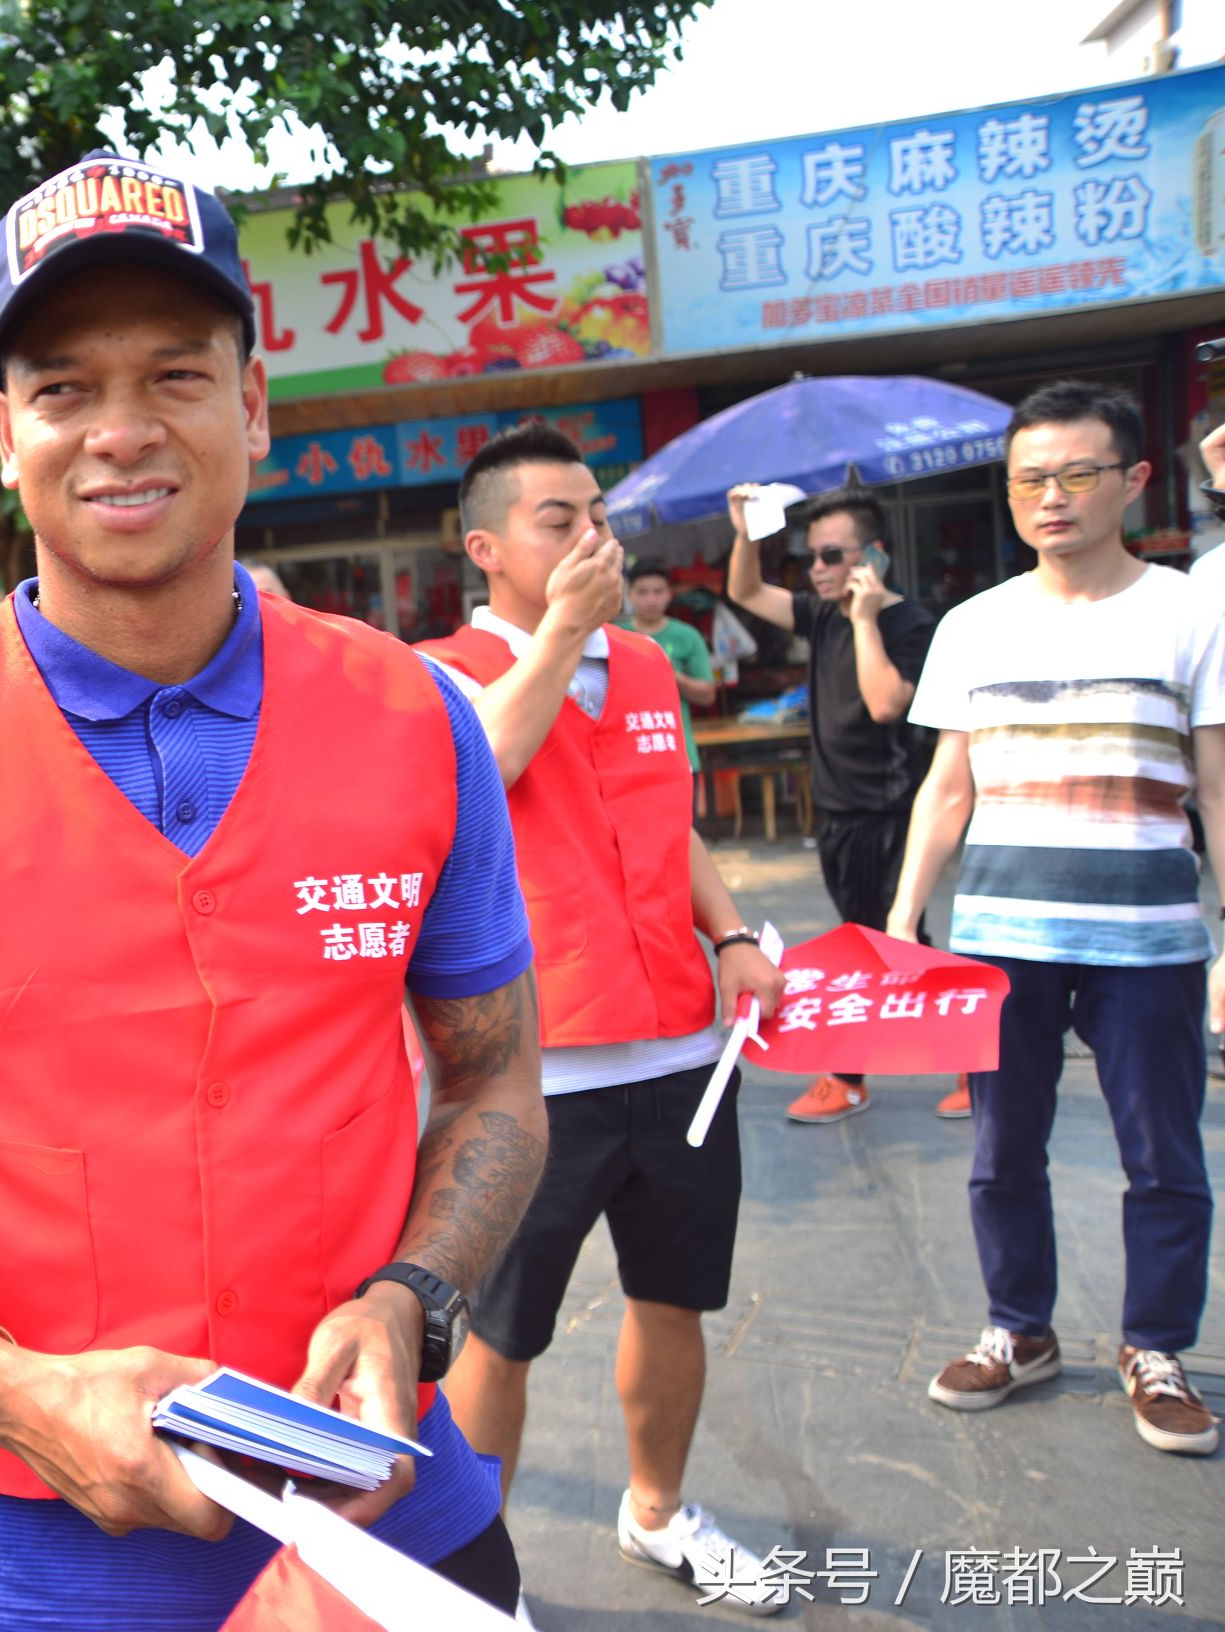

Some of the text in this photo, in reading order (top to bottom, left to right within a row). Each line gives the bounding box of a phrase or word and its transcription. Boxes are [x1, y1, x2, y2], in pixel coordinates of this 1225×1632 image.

[712, 95, 1150, 218] 重庆麻辣烫
[18, 175, 188, 250] DSQUARED
[716, 174, 1152, 291] 重庆酸辣粉
[296, 413, 546, 485] 小仇水果
[293, 872, 424, 915] 交通文明
[319, 920, 412, 961] 志愿者
[778, 987, 989, 1034] 安全出行
